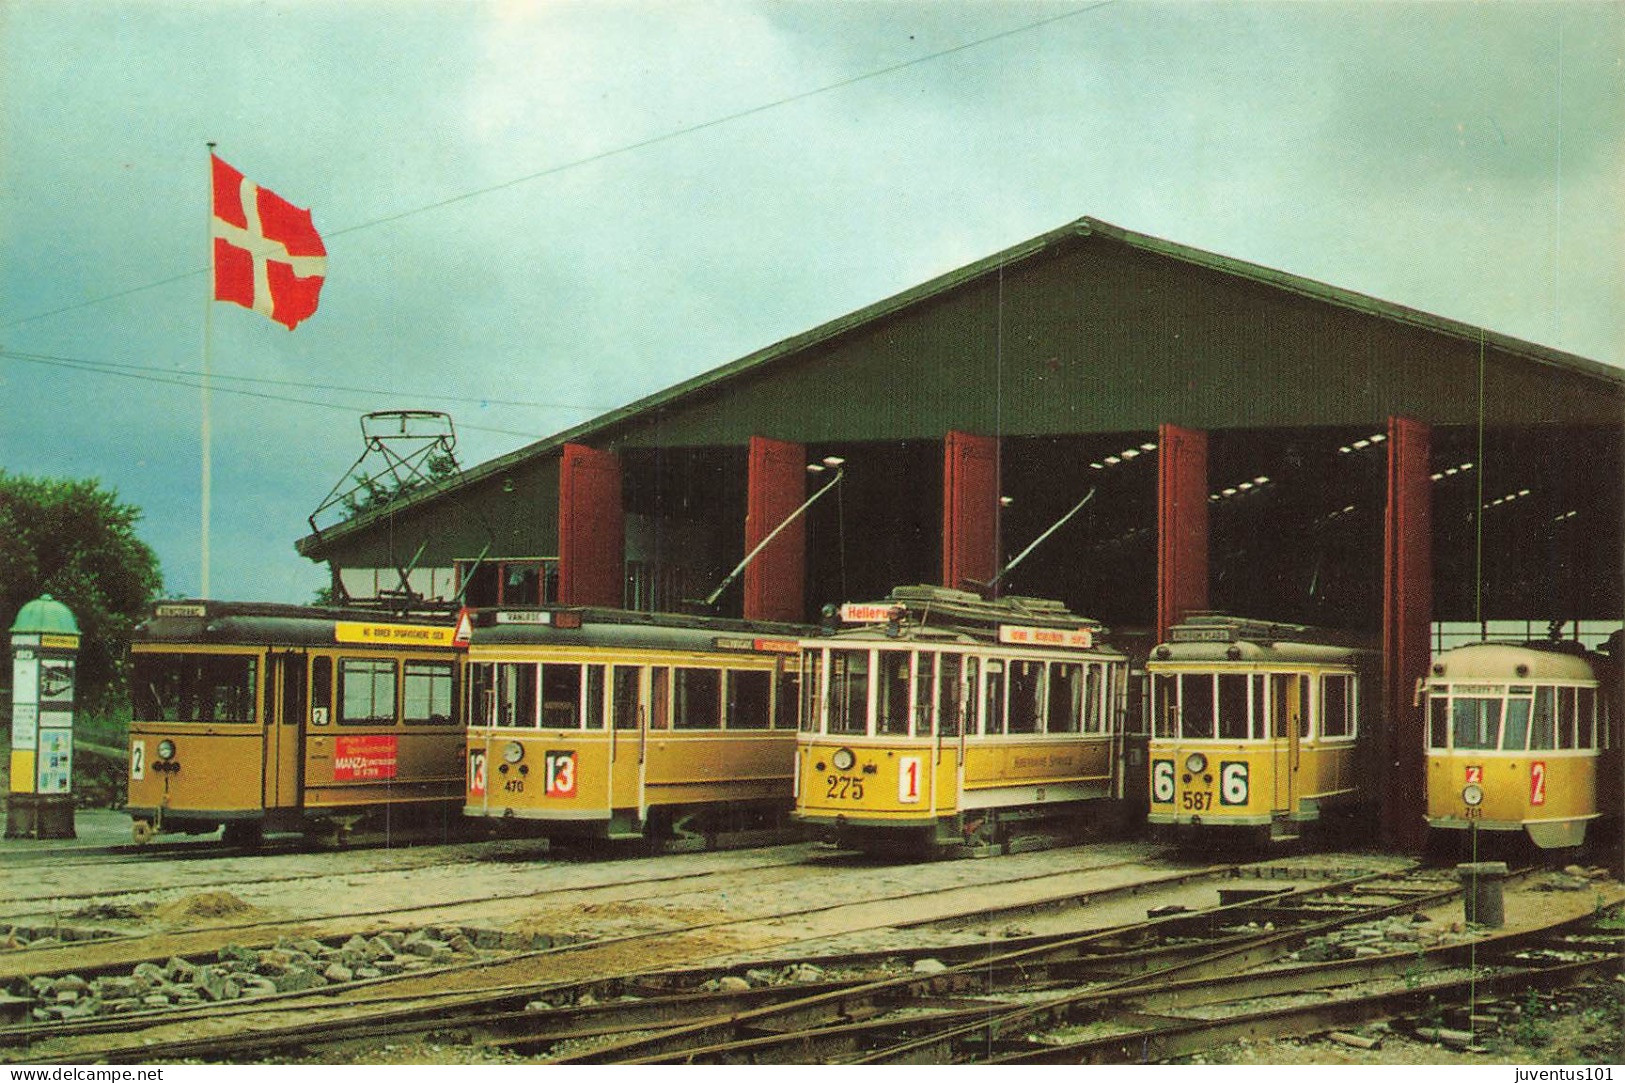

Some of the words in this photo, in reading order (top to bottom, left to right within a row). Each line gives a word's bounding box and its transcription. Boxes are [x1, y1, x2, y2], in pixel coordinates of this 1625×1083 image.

[315, 709, 323, 724] 2
[133, 747, 142, 773] 2
[335, 757, 367, 769] MANZA
[470, 754, 486, 791] 13
[546, 754, 574, 792] 13
[504, 779, 524, 793] 470
[827, 775, 865, 801] 275
[906, 761, 919, 797] 1
[1154, 762, 1174, 802] 6
[1223, 763, 1248, 804] 6
[1533, 764, 1545, 804] 2
[1183, 791, 1213, 811] 587
